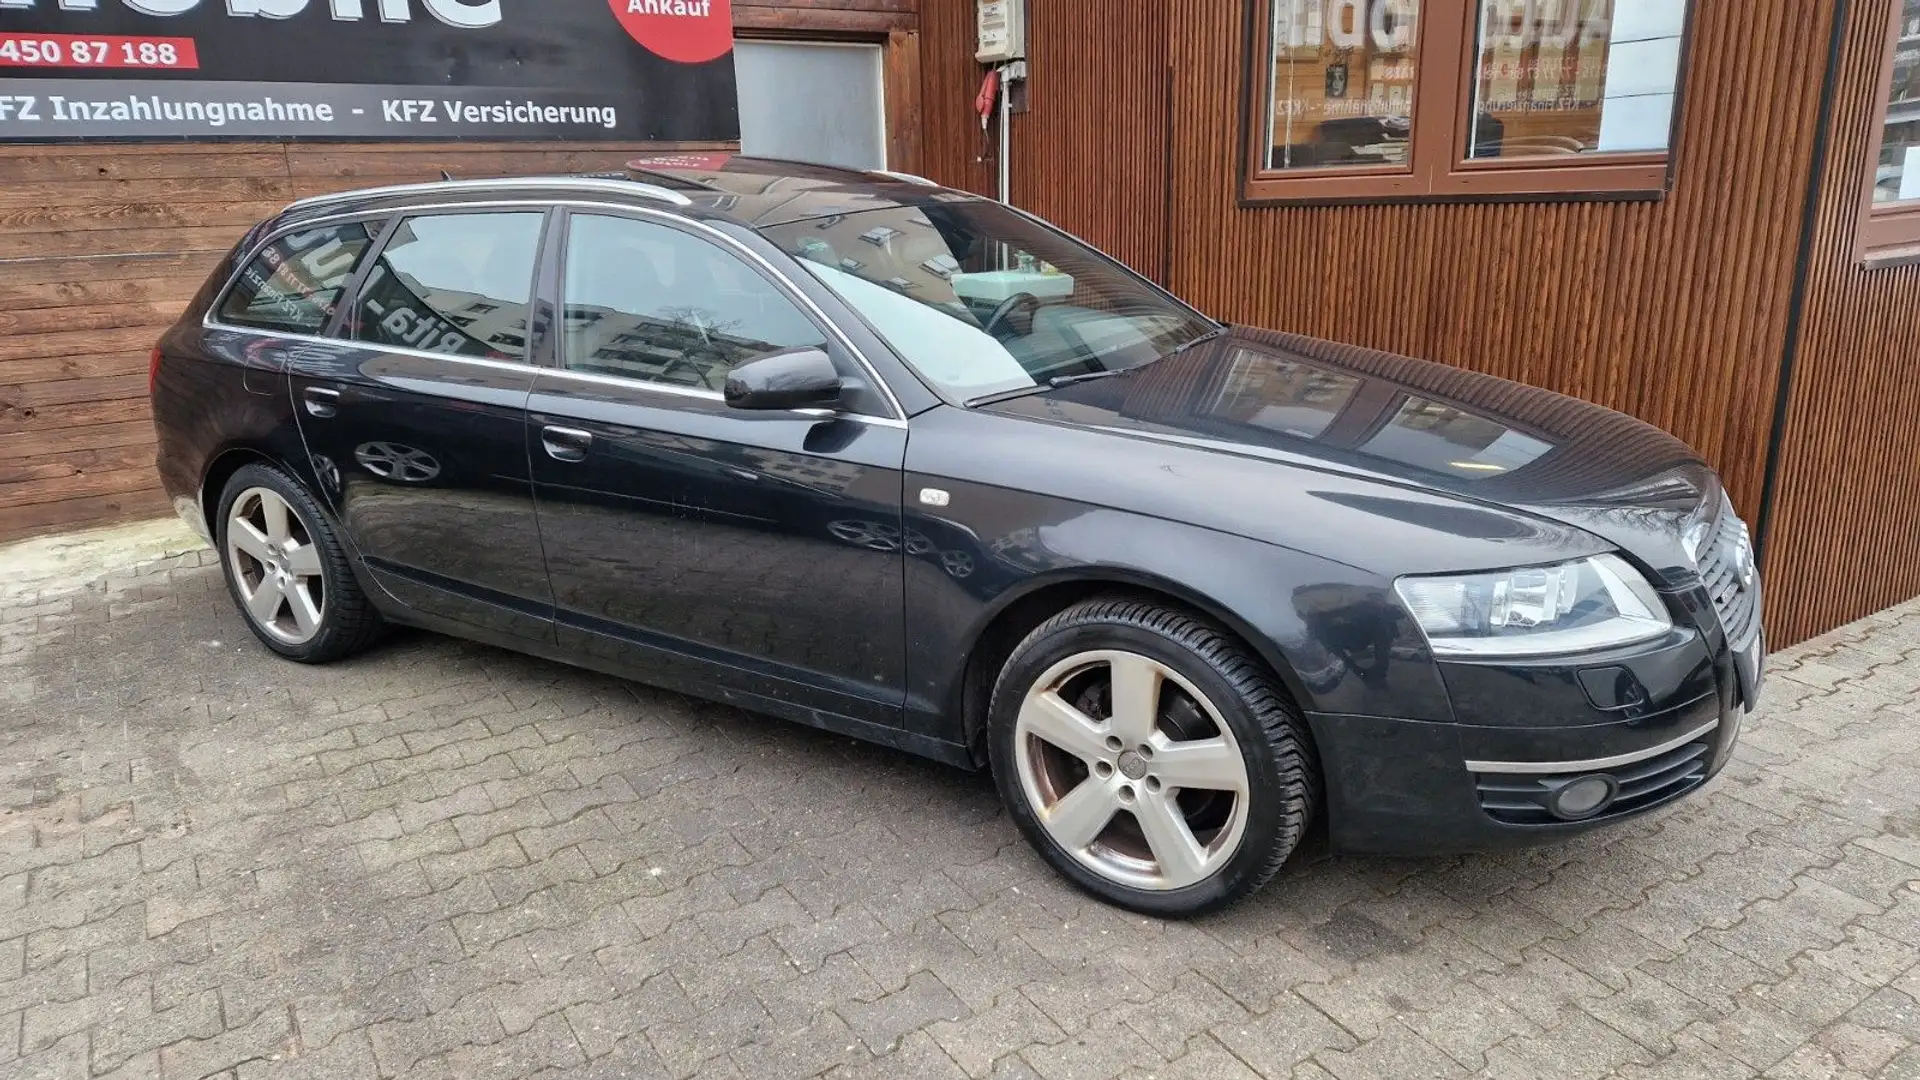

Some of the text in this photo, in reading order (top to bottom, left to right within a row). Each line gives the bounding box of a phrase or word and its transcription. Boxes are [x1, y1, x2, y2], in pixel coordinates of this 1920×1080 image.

[626, 0, 711, 17] Ankauf
[0, 39, 178, 65] 450 87 188
[0, 96, 40, 120] FZ
[49, 95, 334, 126] Inzahlungnahme
[382, 100, 437, 123] KFZ
[443, 100, 617, 128] Versicherung
